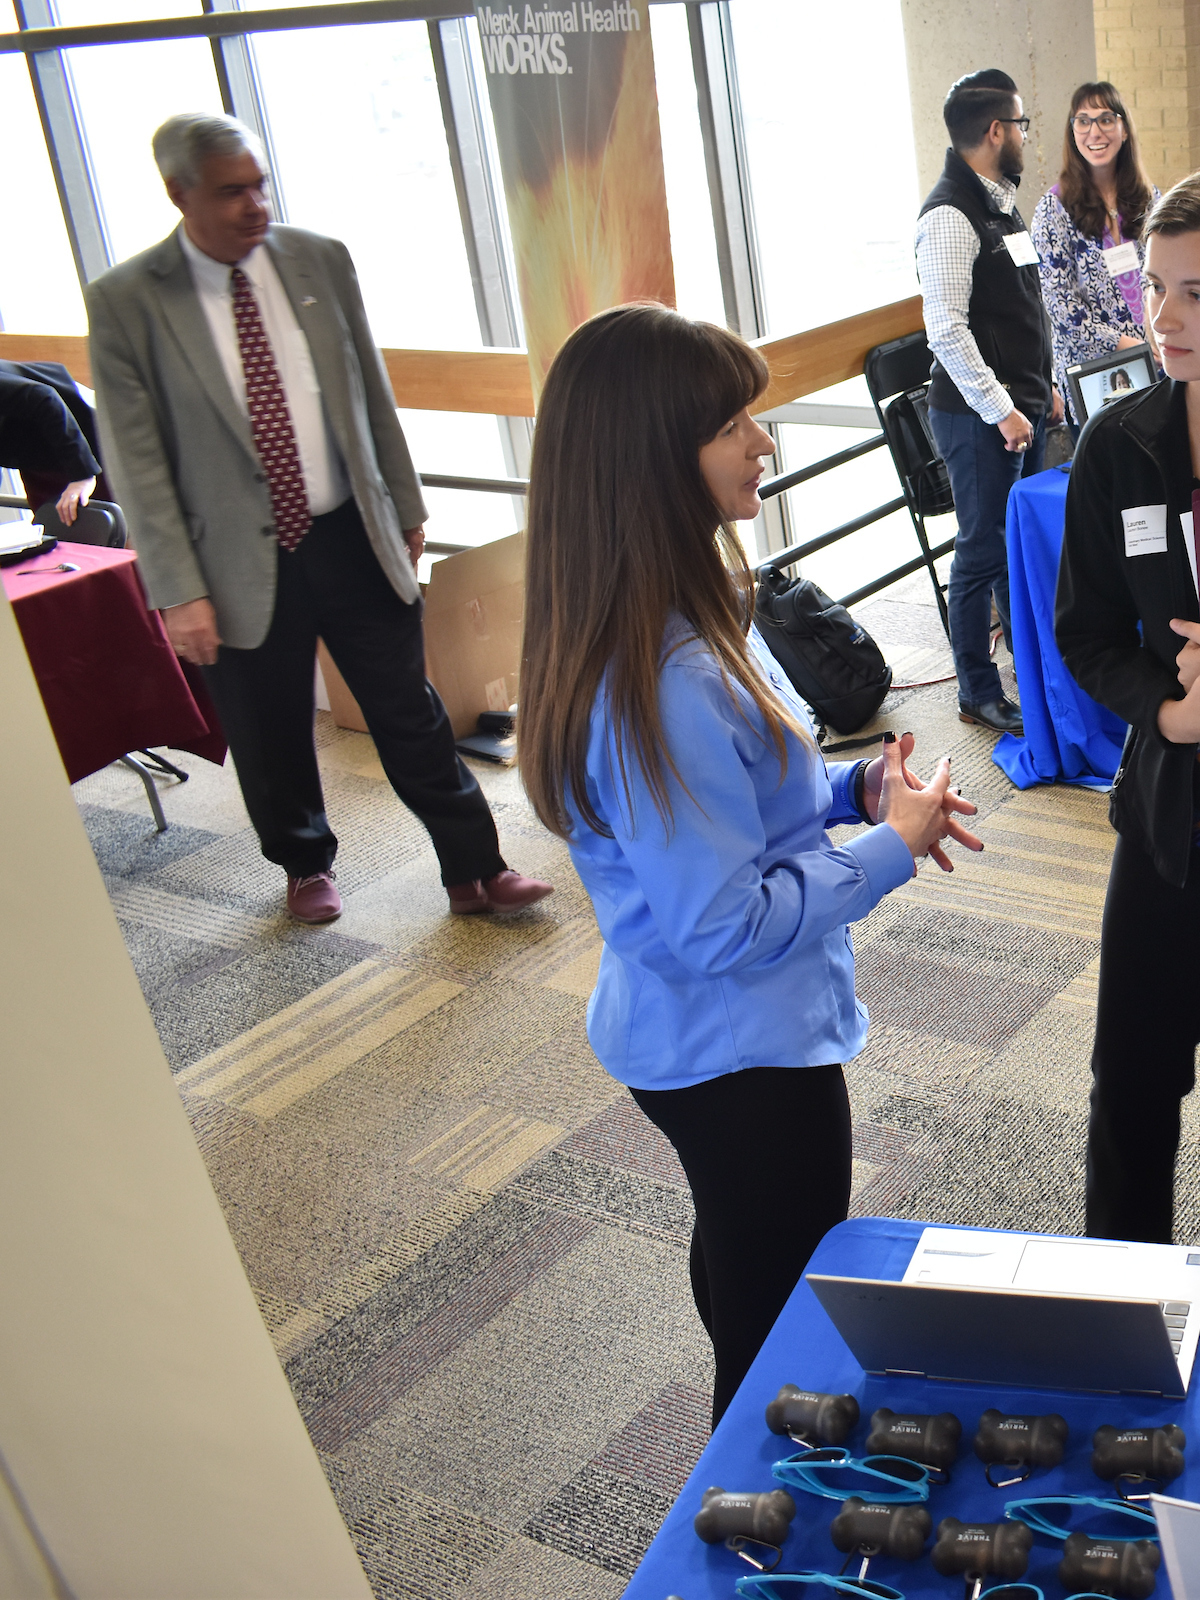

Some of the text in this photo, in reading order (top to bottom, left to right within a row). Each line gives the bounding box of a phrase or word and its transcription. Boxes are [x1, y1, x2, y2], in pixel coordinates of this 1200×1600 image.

[478, 0, 641, 35] Merck Animal Health
[483, 33, 573, 74] WORKS.
[790, 1393, 818, 1403] THRIVE
[891, 1426, 921, 1434] THRIVE
[859, 1506, 890, 1514] THRIVE
[957, 1534, 989, 1542] THRIVE
[1084, 1549, 1118, 1559] THRIVE
